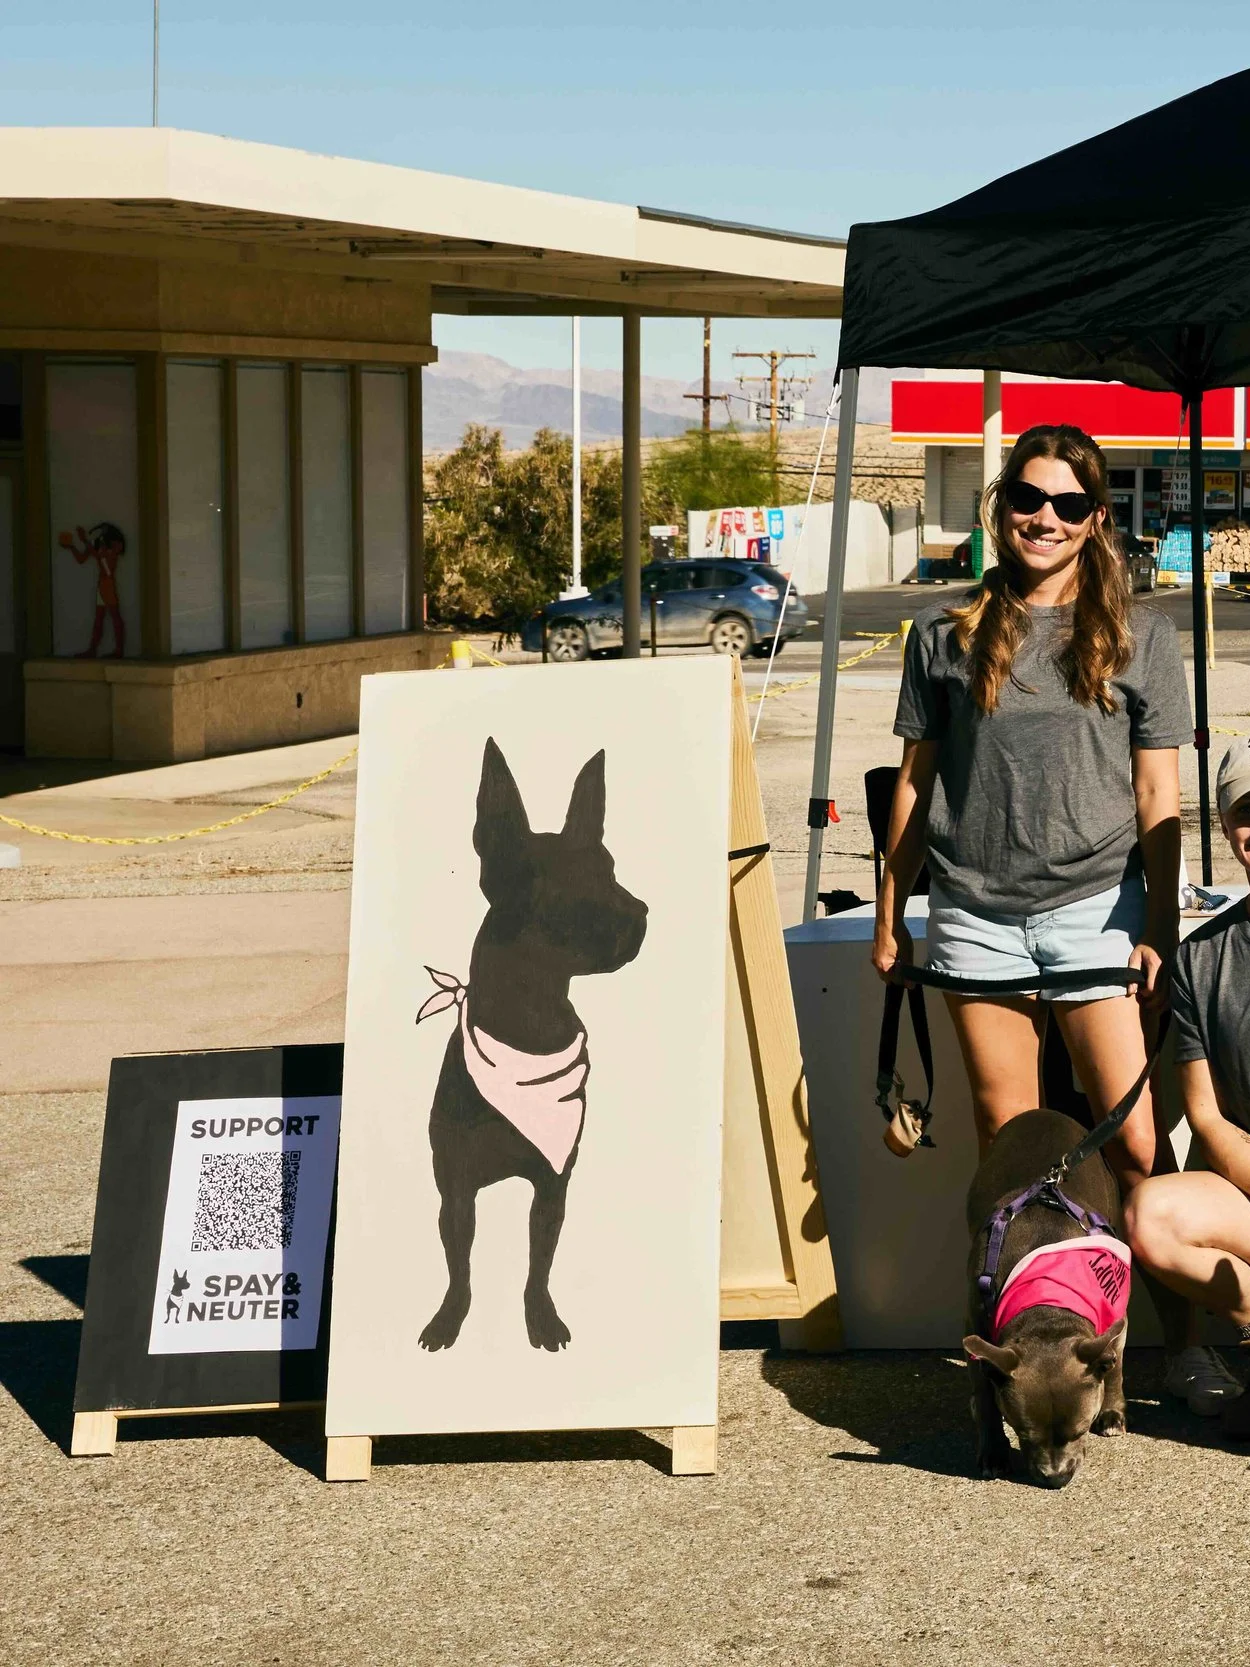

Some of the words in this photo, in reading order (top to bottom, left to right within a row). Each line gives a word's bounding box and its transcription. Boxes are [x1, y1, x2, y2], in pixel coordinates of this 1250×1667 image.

[190, 1115, 320, 1139] SUPPORT
[203, 1272, 301, 1297] SPAY&
[1088, 1252, 1120, 1307] ADOPT
[186, 1298, 300, 1323] NEUTER
